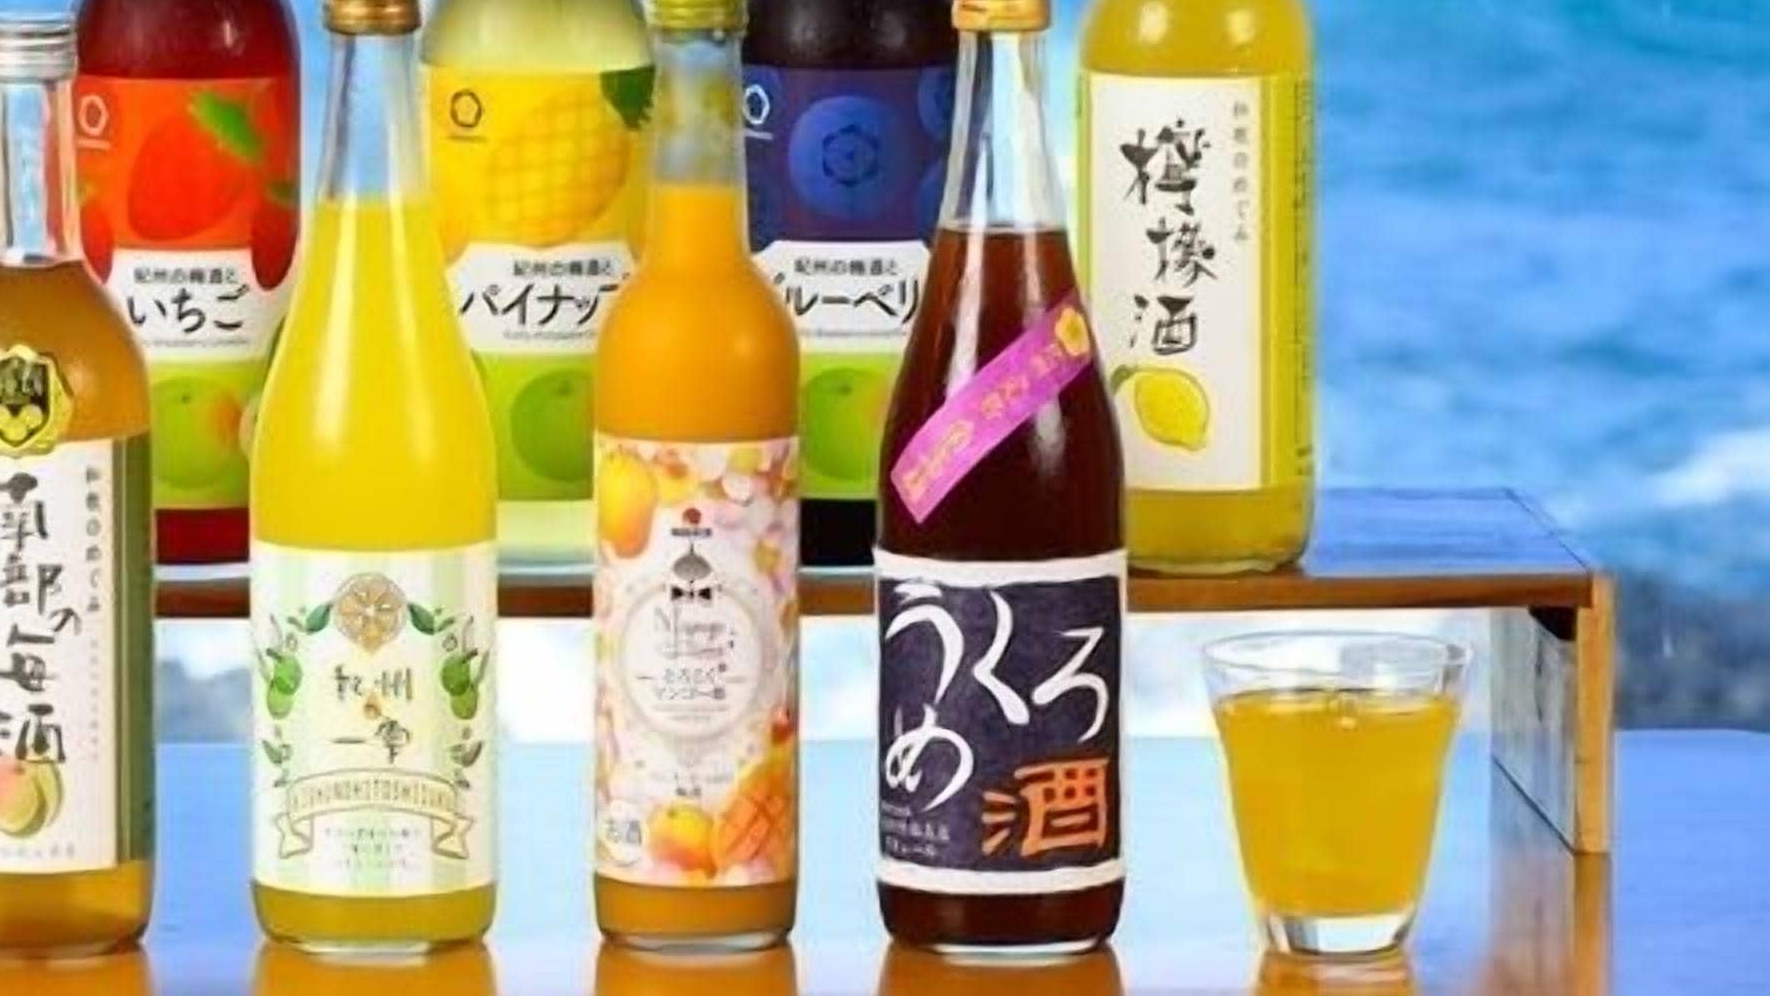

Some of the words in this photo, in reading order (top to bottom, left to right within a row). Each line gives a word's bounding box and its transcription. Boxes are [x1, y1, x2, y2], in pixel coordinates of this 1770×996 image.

[126, 283, 250, 334] いちご
[774, 272, 920, 324] ルーベリ
[982, 757, 1110, 857] 酒
